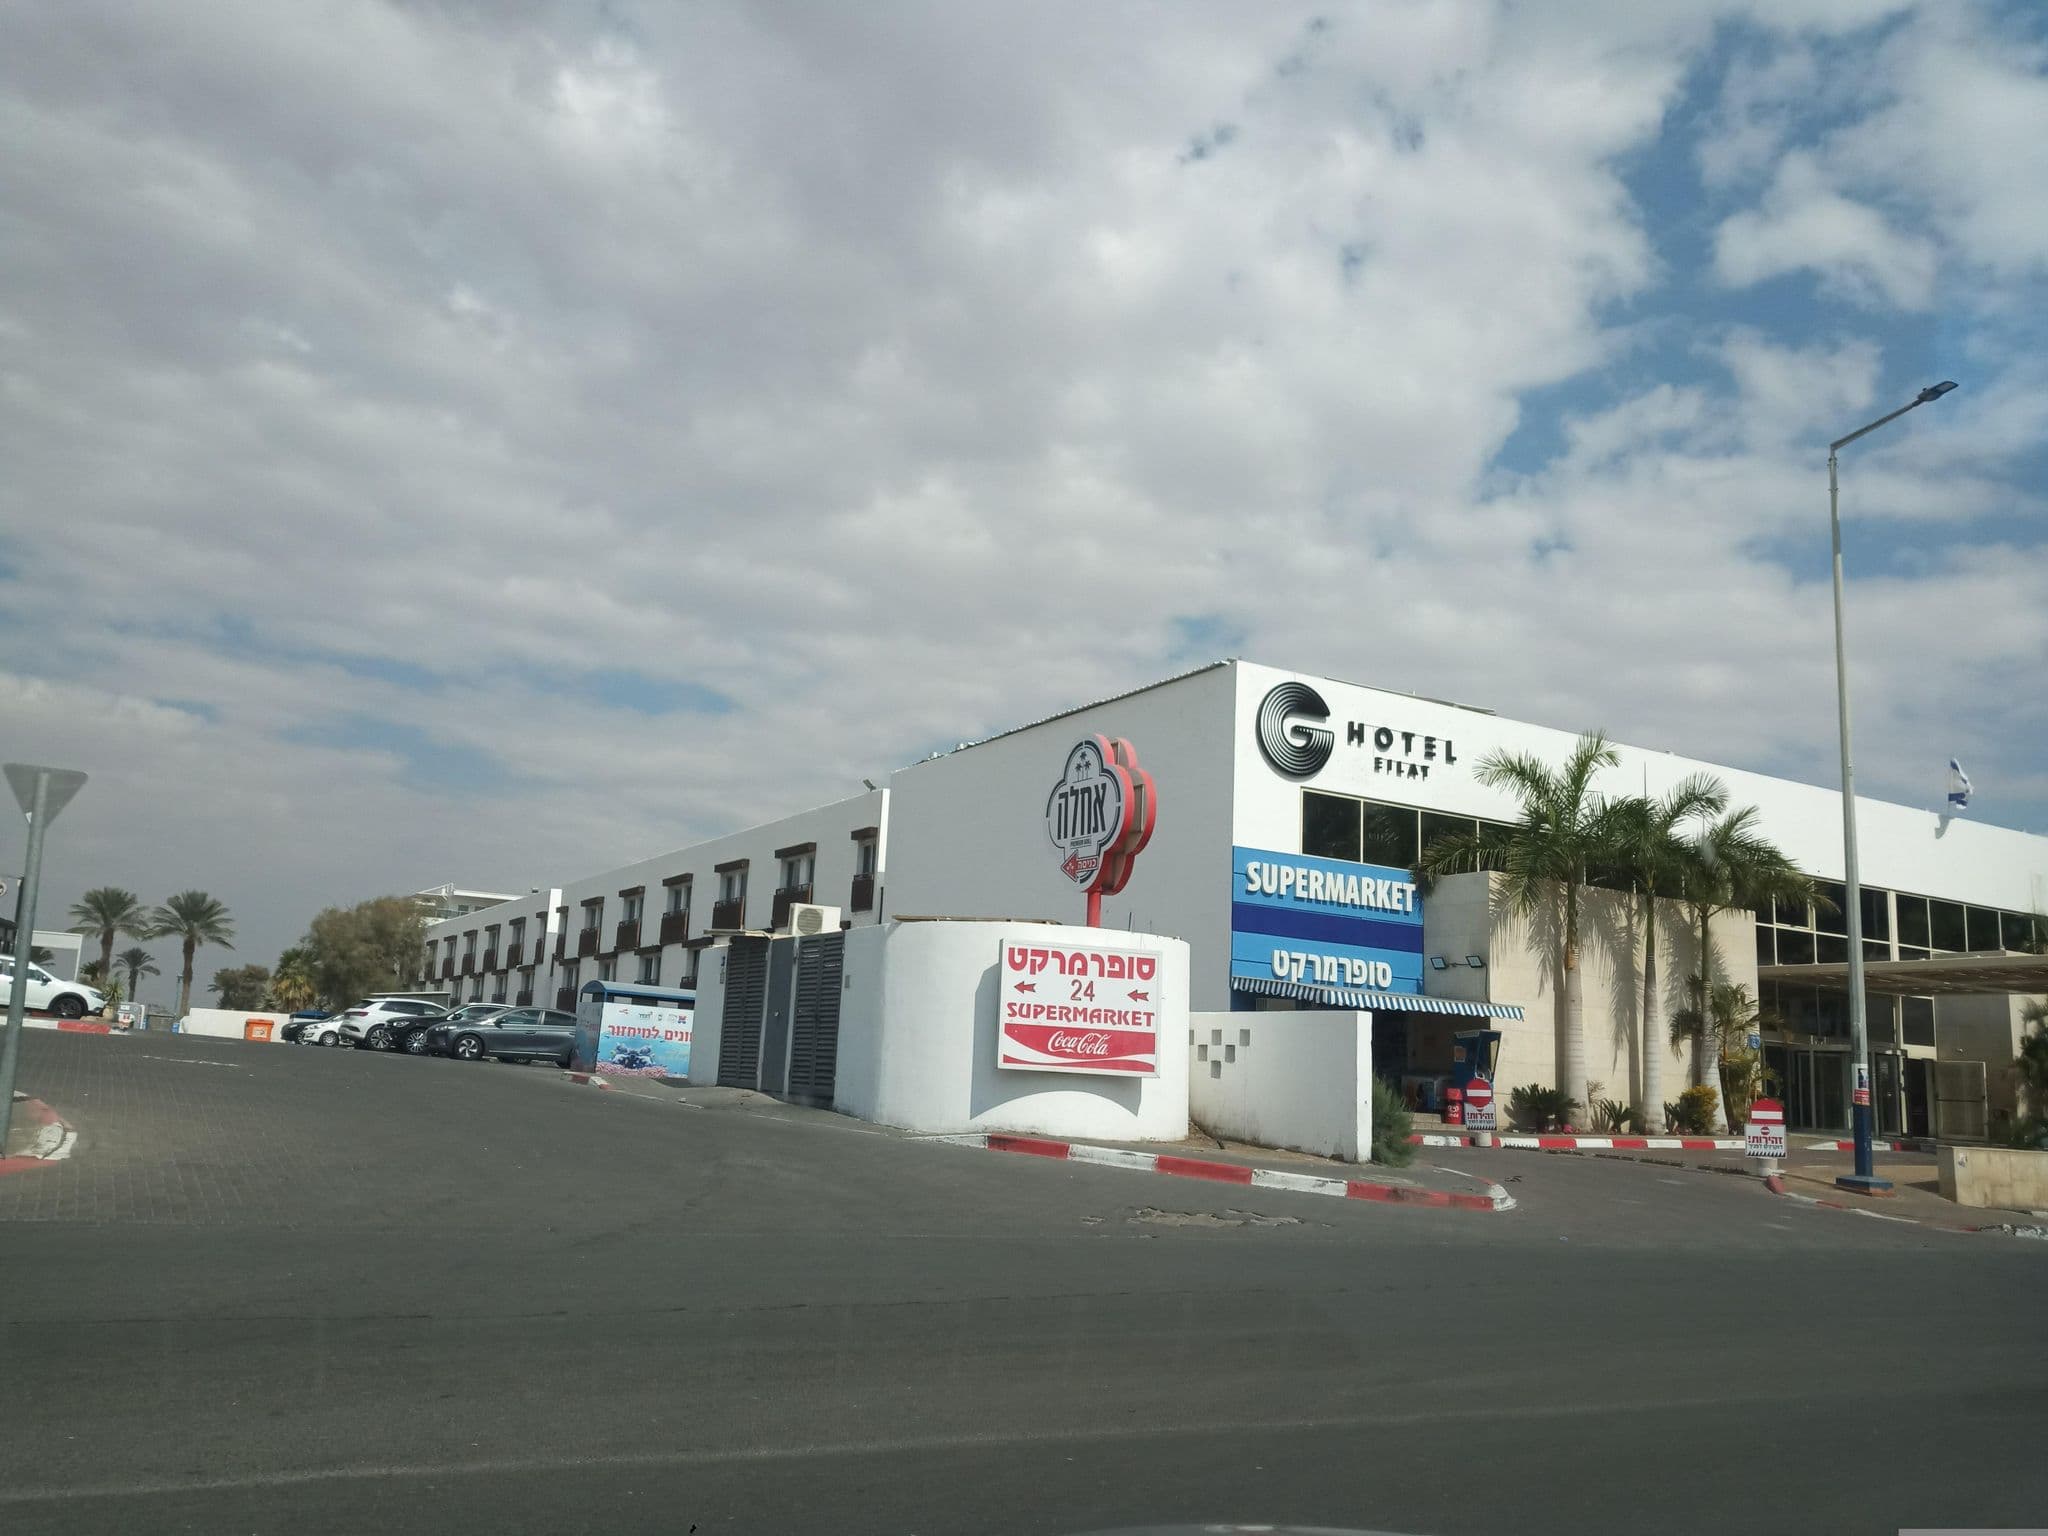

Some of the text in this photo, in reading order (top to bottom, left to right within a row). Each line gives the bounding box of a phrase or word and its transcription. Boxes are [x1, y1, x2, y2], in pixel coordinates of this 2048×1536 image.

[1347, 720, 1457, 765] HOTEL
[1374, 757, 1430, 781] EILAT
[1057, 782, 1107, 840] אחלה
[1077, 858, 1097, 870] כניסה
[1246, 861, 1417, 913] SUPERMARKET
[1008, 947, 1156, 981] סופרמרקט
[1272, 949, 1393, 988] סופרמרקט
[1070, 979, 1096, 1002] 24
[1006, 1002, 1155, 1027] SUPERMARKET
[607, 1024, 660, 1040] למיחזור
[1048, 1030, 1112, 1056] Coca-Cola
